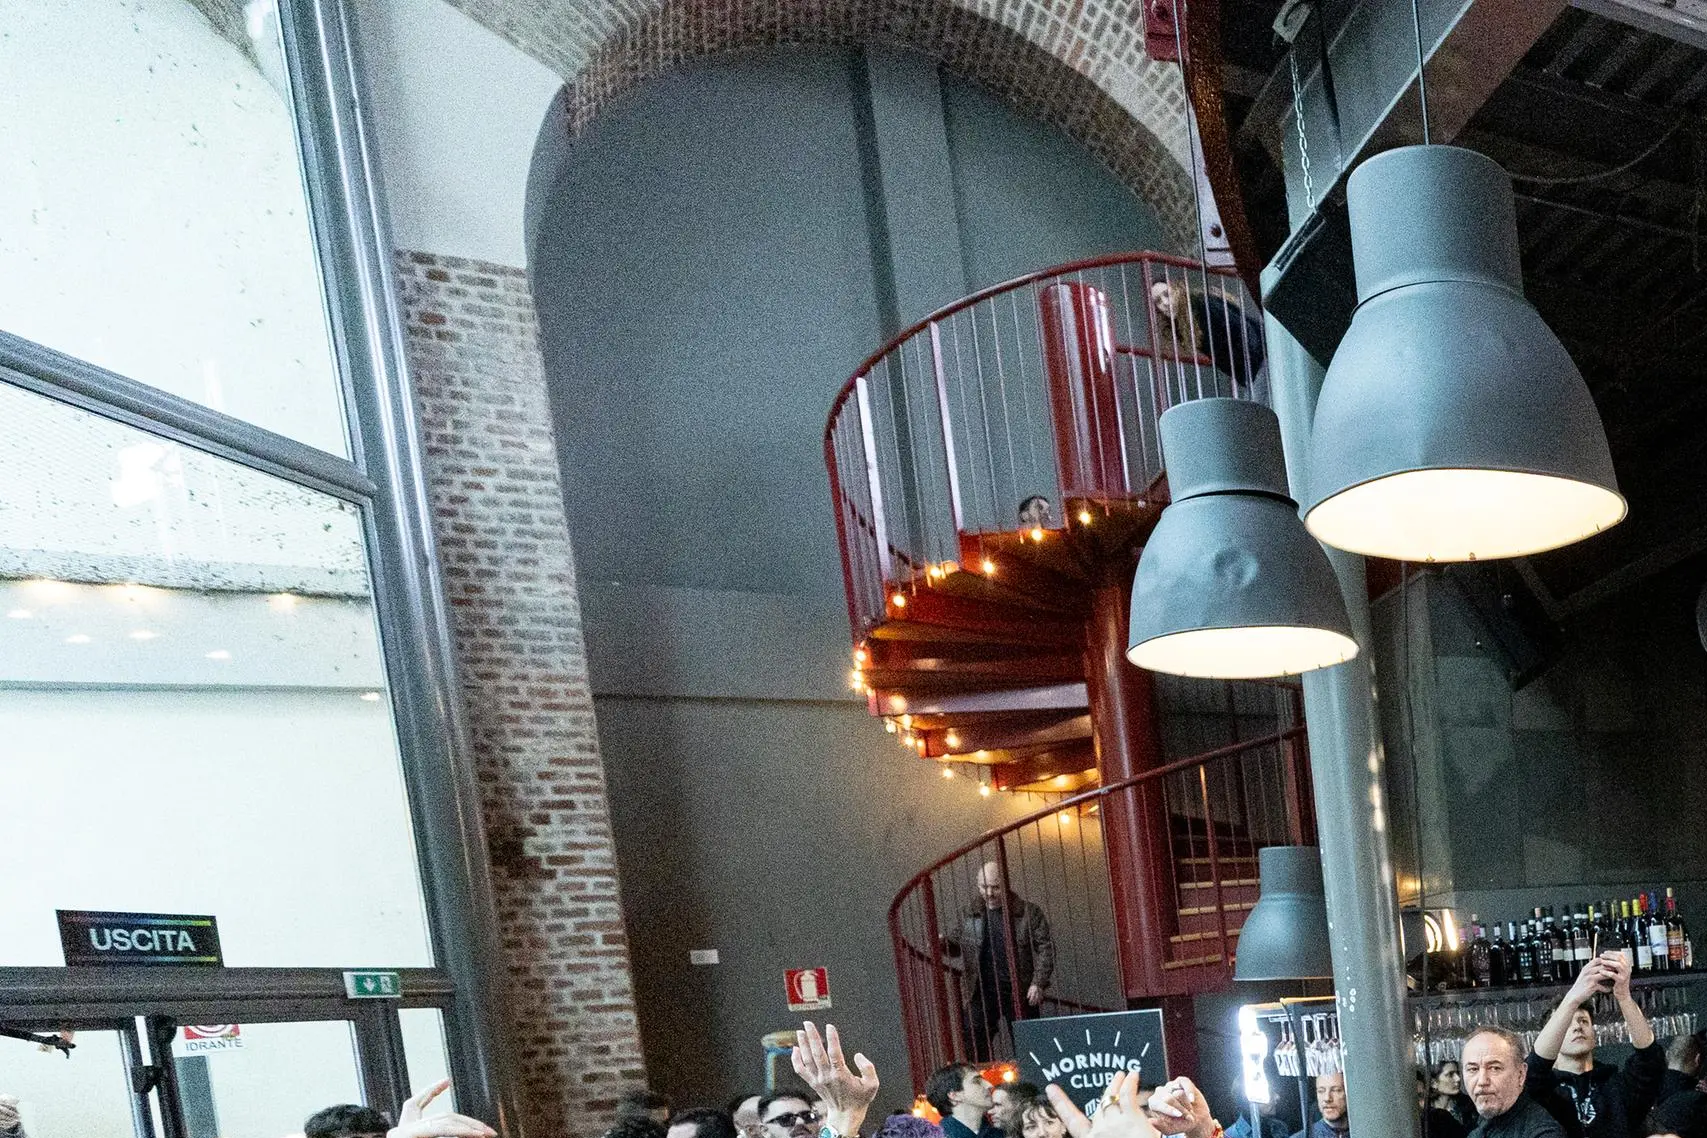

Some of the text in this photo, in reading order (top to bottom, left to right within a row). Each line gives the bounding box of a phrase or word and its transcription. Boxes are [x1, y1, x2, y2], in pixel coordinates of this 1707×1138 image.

[89, 928, 197, 952] USCITA
[186, 1038, 244, 1052] IDRANTE
[1042, 1053, 1142, 1082] MORNING
[1070, 1072, 1114, 1089] CLUB
